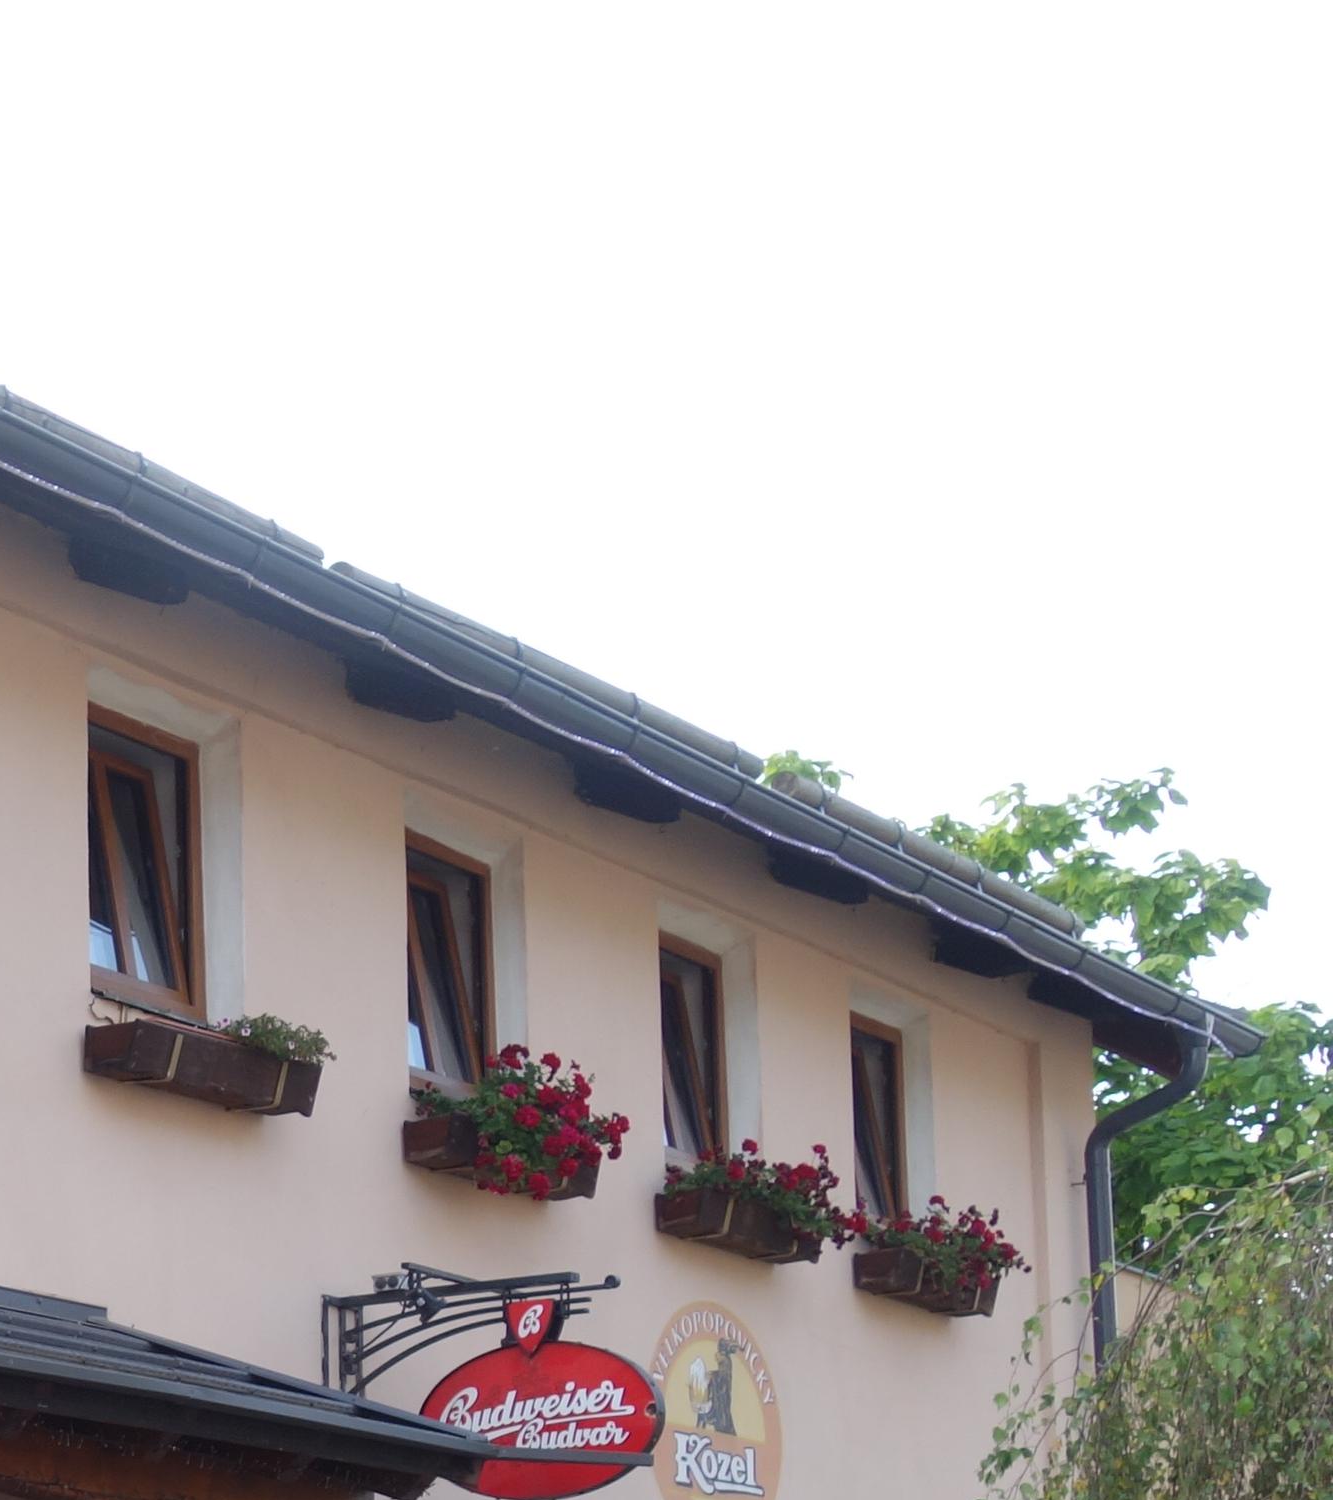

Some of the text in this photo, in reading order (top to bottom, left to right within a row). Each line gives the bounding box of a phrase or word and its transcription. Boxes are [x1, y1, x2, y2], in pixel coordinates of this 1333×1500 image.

[439, 1380, 635, 1440] Budweiser
[516, 1417, 629, 1450] Budvar
[674, 1431, 764, 1496] Kozel
